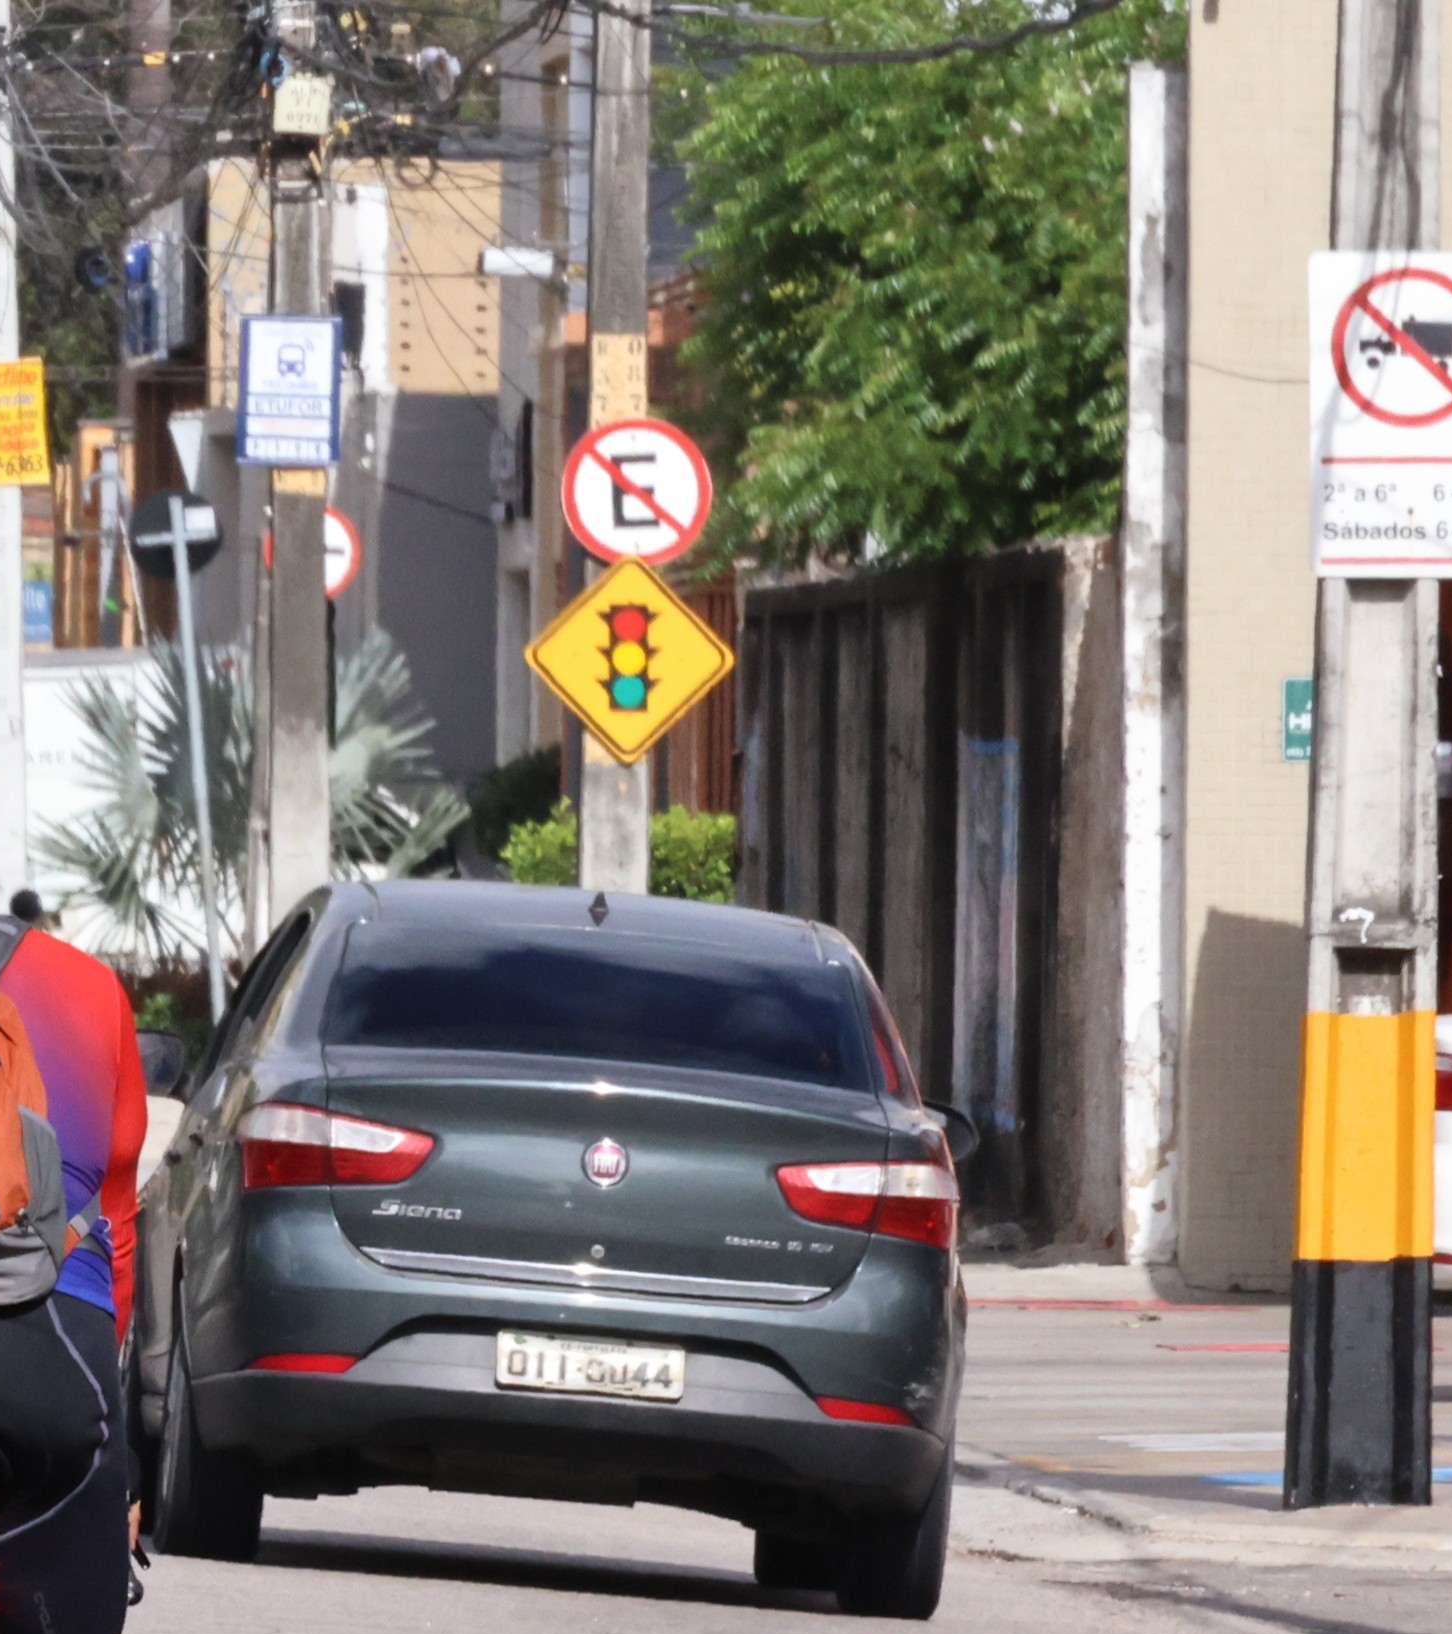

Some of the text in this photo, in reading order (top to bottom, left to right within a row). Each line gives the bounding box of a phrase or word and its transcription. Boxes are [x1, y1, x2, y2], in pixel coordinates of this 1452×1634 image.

[254, 400, 323, 415] ETUFOR
[1354, 487, 1366, 502] a
[1323, 521, 1427, 540] Sábados
[372, 1199, 462, 1220] Siena
